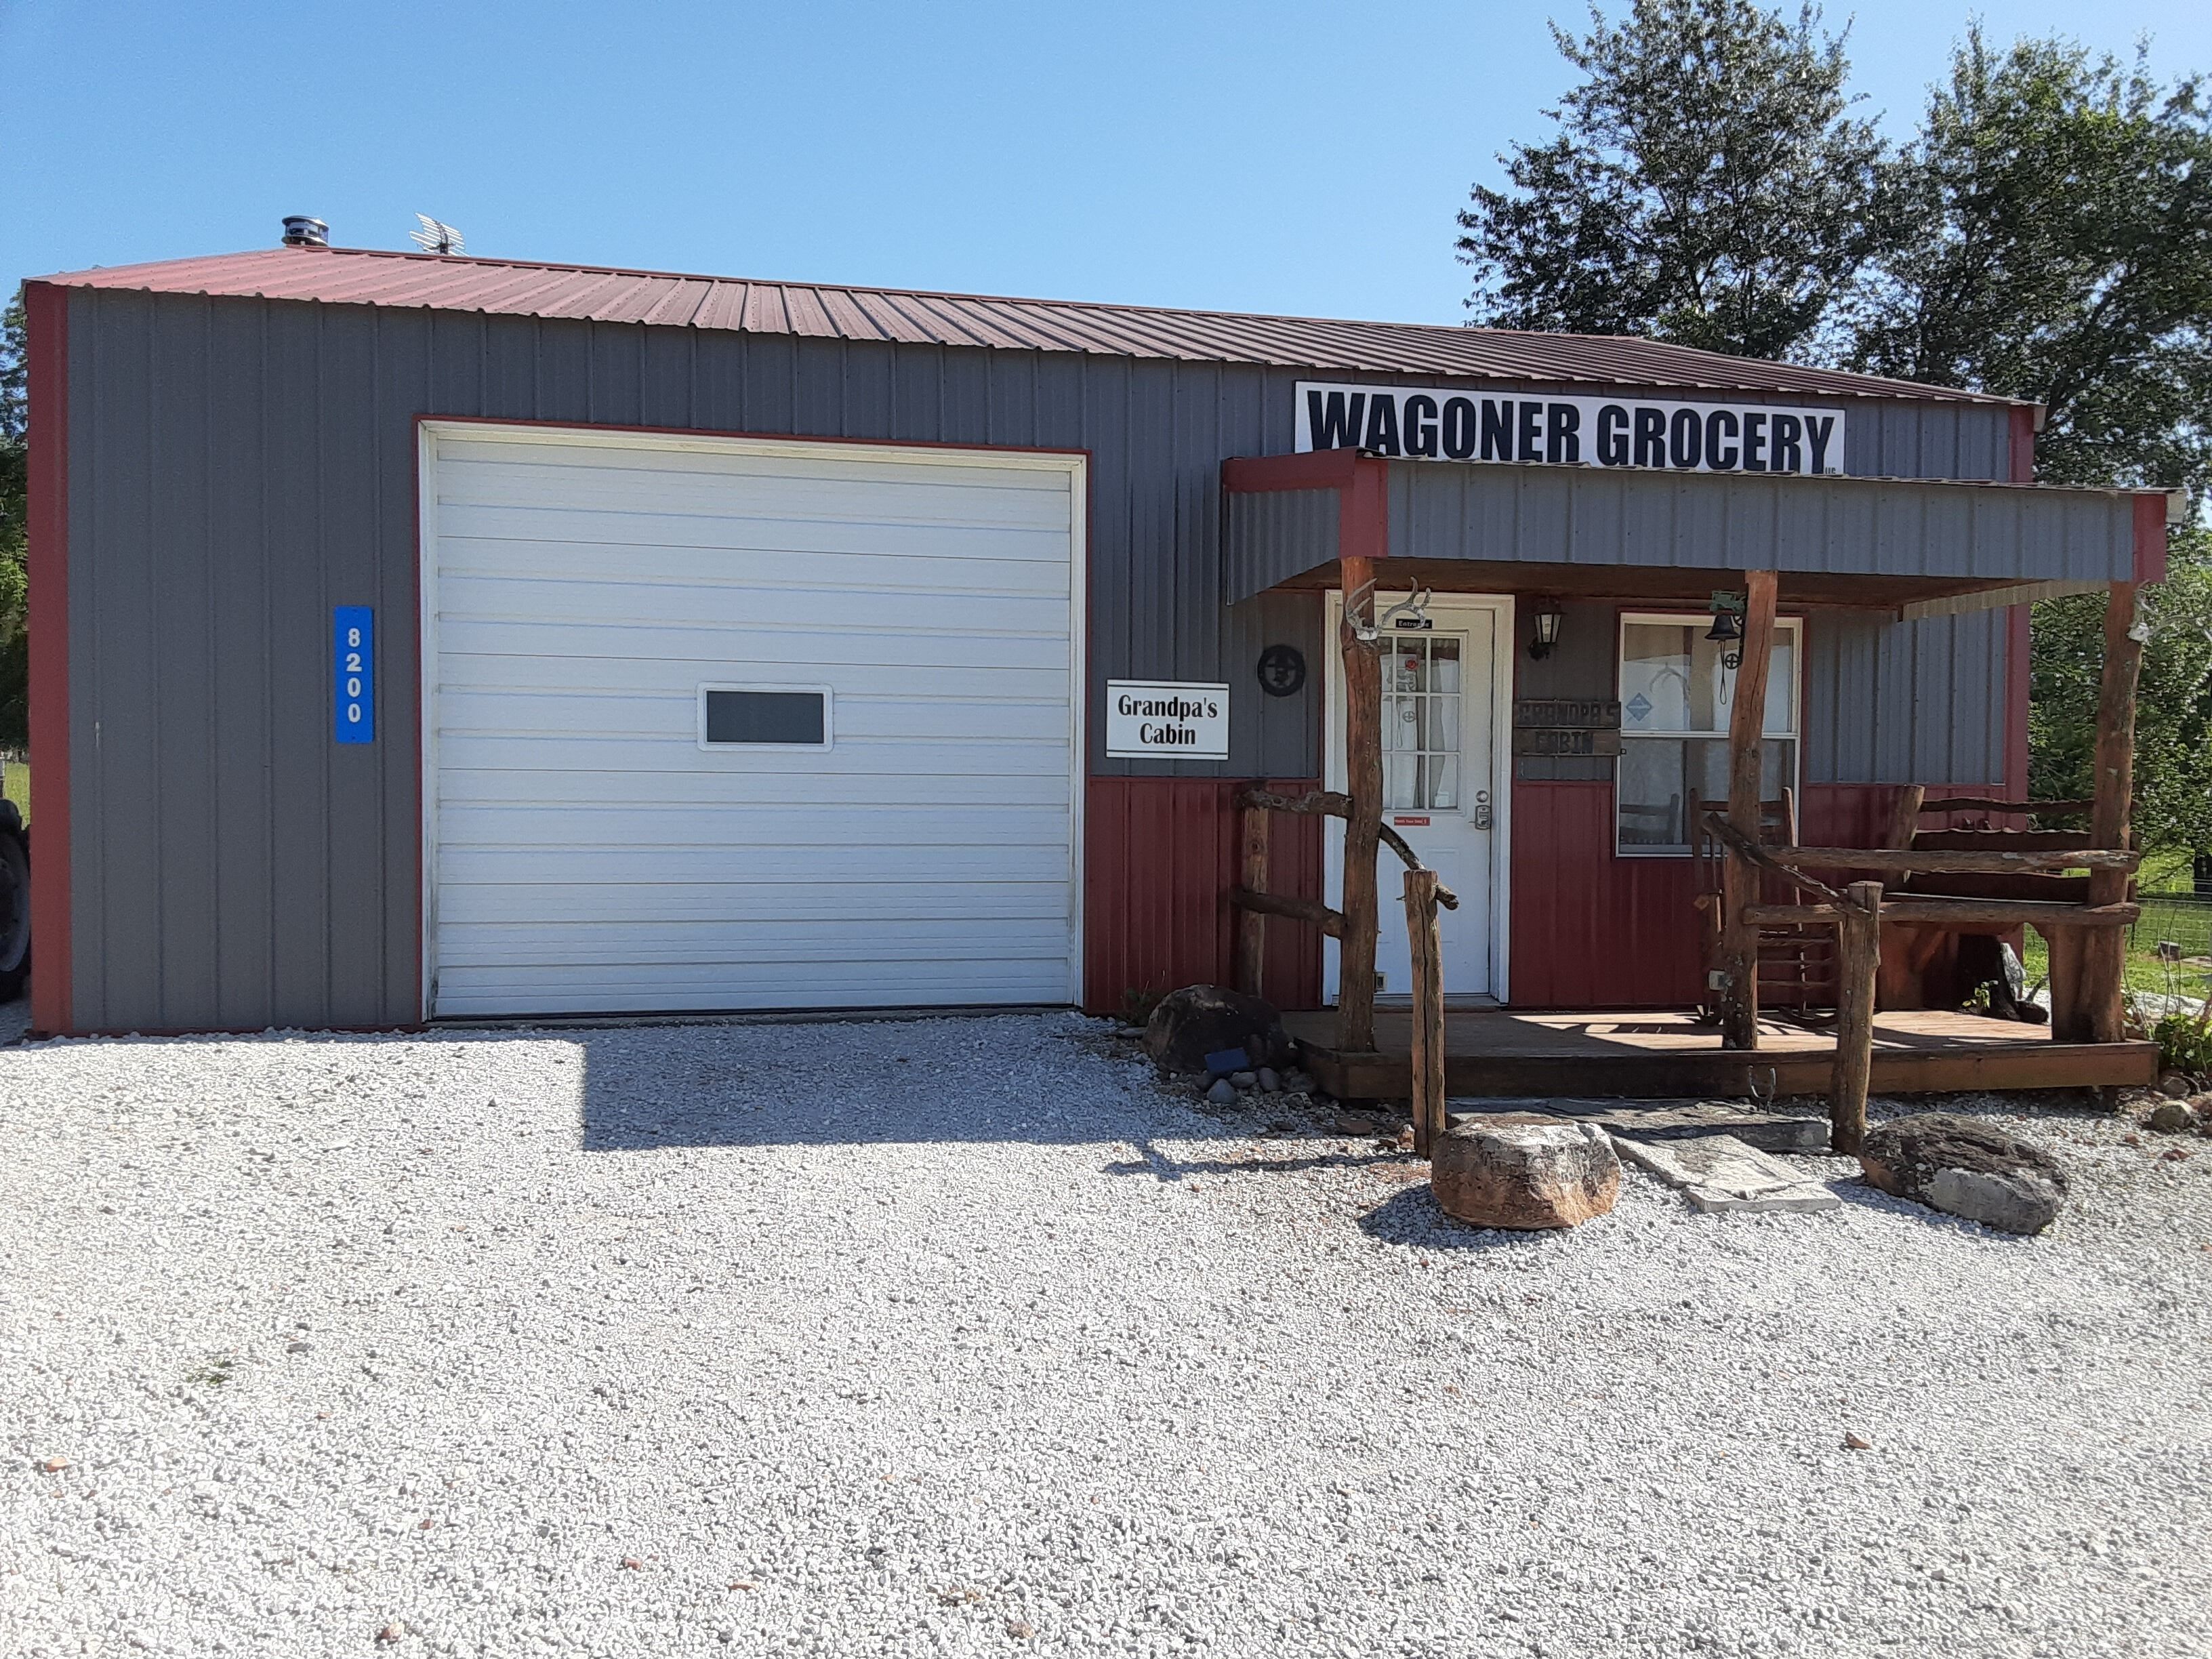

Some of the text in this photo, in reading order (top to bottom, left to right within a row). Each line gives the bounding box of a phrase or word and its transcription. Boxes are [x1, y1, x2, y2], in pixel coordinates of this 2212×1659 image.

[1307, 390, 1835, 474] WAGONER GROCERY
[346, 628, 363, 723] 8200
[1118, 695, 1218, 722] Grandpa's
[1140, 722, 1195, 744] Cabin
